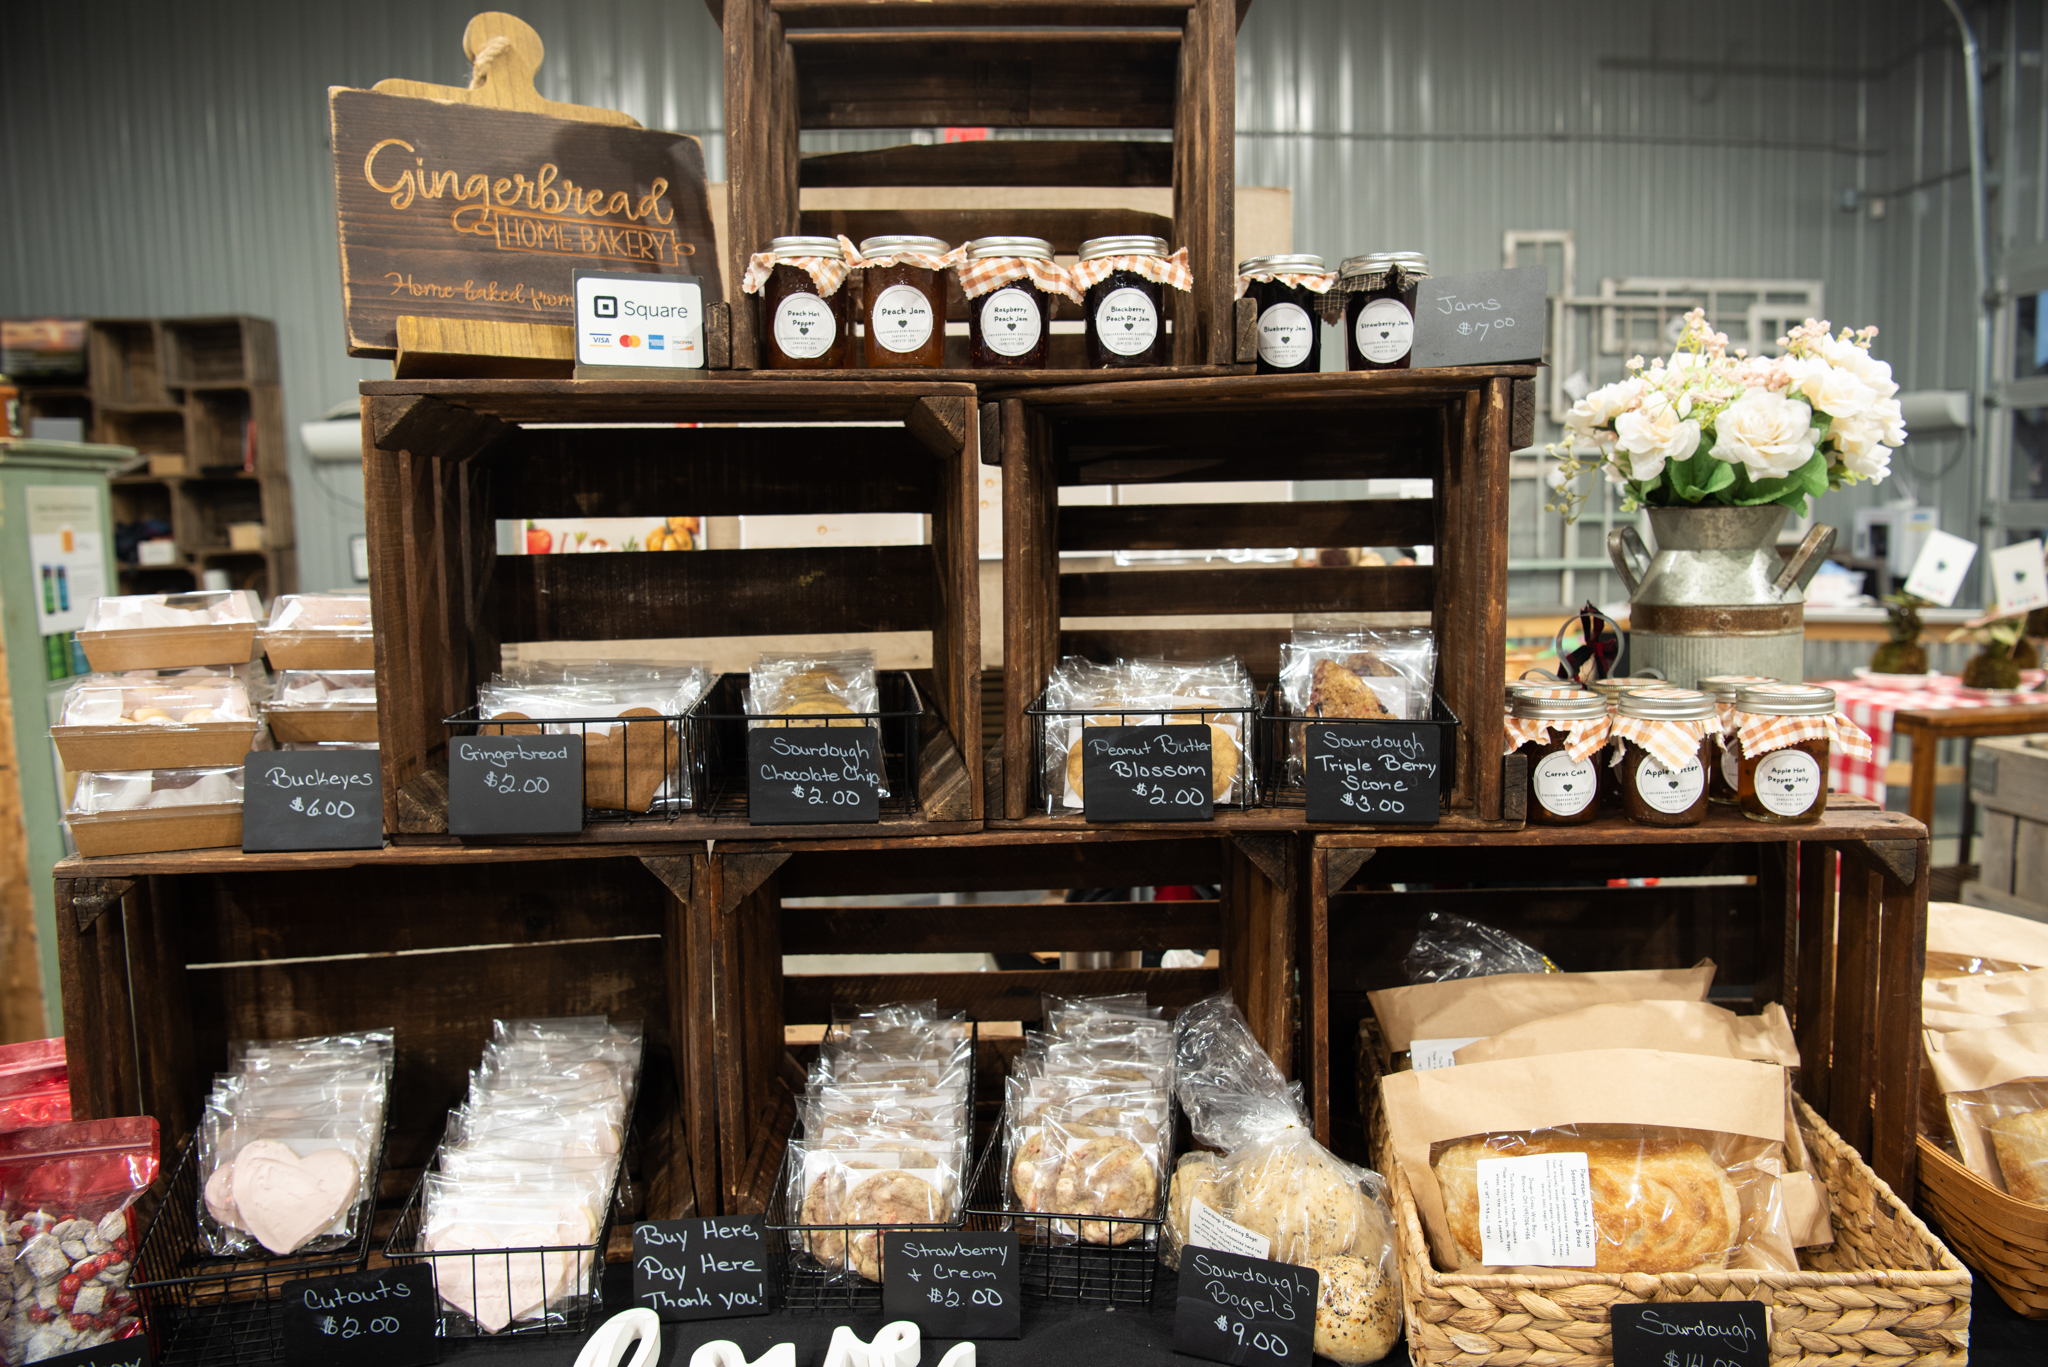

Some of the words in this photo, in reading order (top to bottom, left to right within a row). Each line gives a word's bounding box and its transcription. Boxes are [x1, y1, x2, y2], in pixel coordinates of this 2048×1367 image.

[364, 138, 674, 235] Gingerbread
[504, 217, 573, 252] HOME
[579, 226, 668, 261] BAKERY
[384, 271, 526, 304] Home-baked
[624, 300, 688, 321] Square
[881, 307, 907, 317] Peach
[909, 306, 926, 315] Jam
[994, 306, 1028, 314] Raspberry
[1110, 305, 1146, 315] Blackberry
[1437, 295, 1501, 314] Jams
[792, 319, 815, 328] Pepper
[1105, 315, 1125, 323] Peach
[1263, 325, 1294, 333] Blueberry
[1360, 321, 1396, 330] Strawberry
[1397, 319, 1409, 327] Jam
[592, 336, 610, 344] VISA
[460, 743, 568, 768] Gingerbread
[770, 737, 870, 770] Sourdough
[1087, 738, 1152, 757] Peanut
[1153, 733, 1212, 755] Butter
[1322, 731, 1425, 760] Sourdough
[760, 764, 841, 782] Chocolate
[842, 764, 880, 788] Chip
[1109, 760, 1206, 778] Blossom
[1314, 754, 1373, 775] Triple
[1378, 753, 1437, 779] Berry
[1544, 770, 1570, 778] Carrot
[1570, 769, 1587, 777] Cake
[1644, 768, 1670, 779] Apple
[1672, 765, 1699, 775] utter
[1771, 767, 1792, 776] Apple
[265, 766, 373, 790] Buckeyes
[483, 771, 551, 793] $2.00
[1340, 774, 1409, 792] Scone
[1767, 775, 1792, 785] Pepper
[1794, 776, 1810, 784] Jelly
[791, 784, 861, 806] $2.00
[1131, 782, 1205, 806] $2.00
[1340, 792, 1405, 814] $3.00
[289, 796, 356, 818] $6.00
[1570, 1169, 1579, 1195] Seasoning
[1572, 1198, 1581, 1226] Sourdough
[635, 1224, 688, 1252] Buy
[702, 1220, 760, 1241] Here,
[902, 1241, 1009, 1265] Strawberry
[637, 1256, 687, 1290] Pay
[701, 1254, 762, 1275] Here
[933, 1264, 997, 1281] Cream
[1193, 1254, 1310, 1303] Sourdough
[303, 1279, 411, 1310] Cutouts
[641, 1288, 712, 1310] Thank
[722, 1287, 763, 1310] you!
[927, 1287, 1004, 1308] $2.00
[1205, 1280, 1296, 1320] Bagels
[320, 1315, 400, 1339] $2.00
[1213, 1314, 1288, 1357] $9.00
[1636, 1310, 1757, 1353] Sourdough
